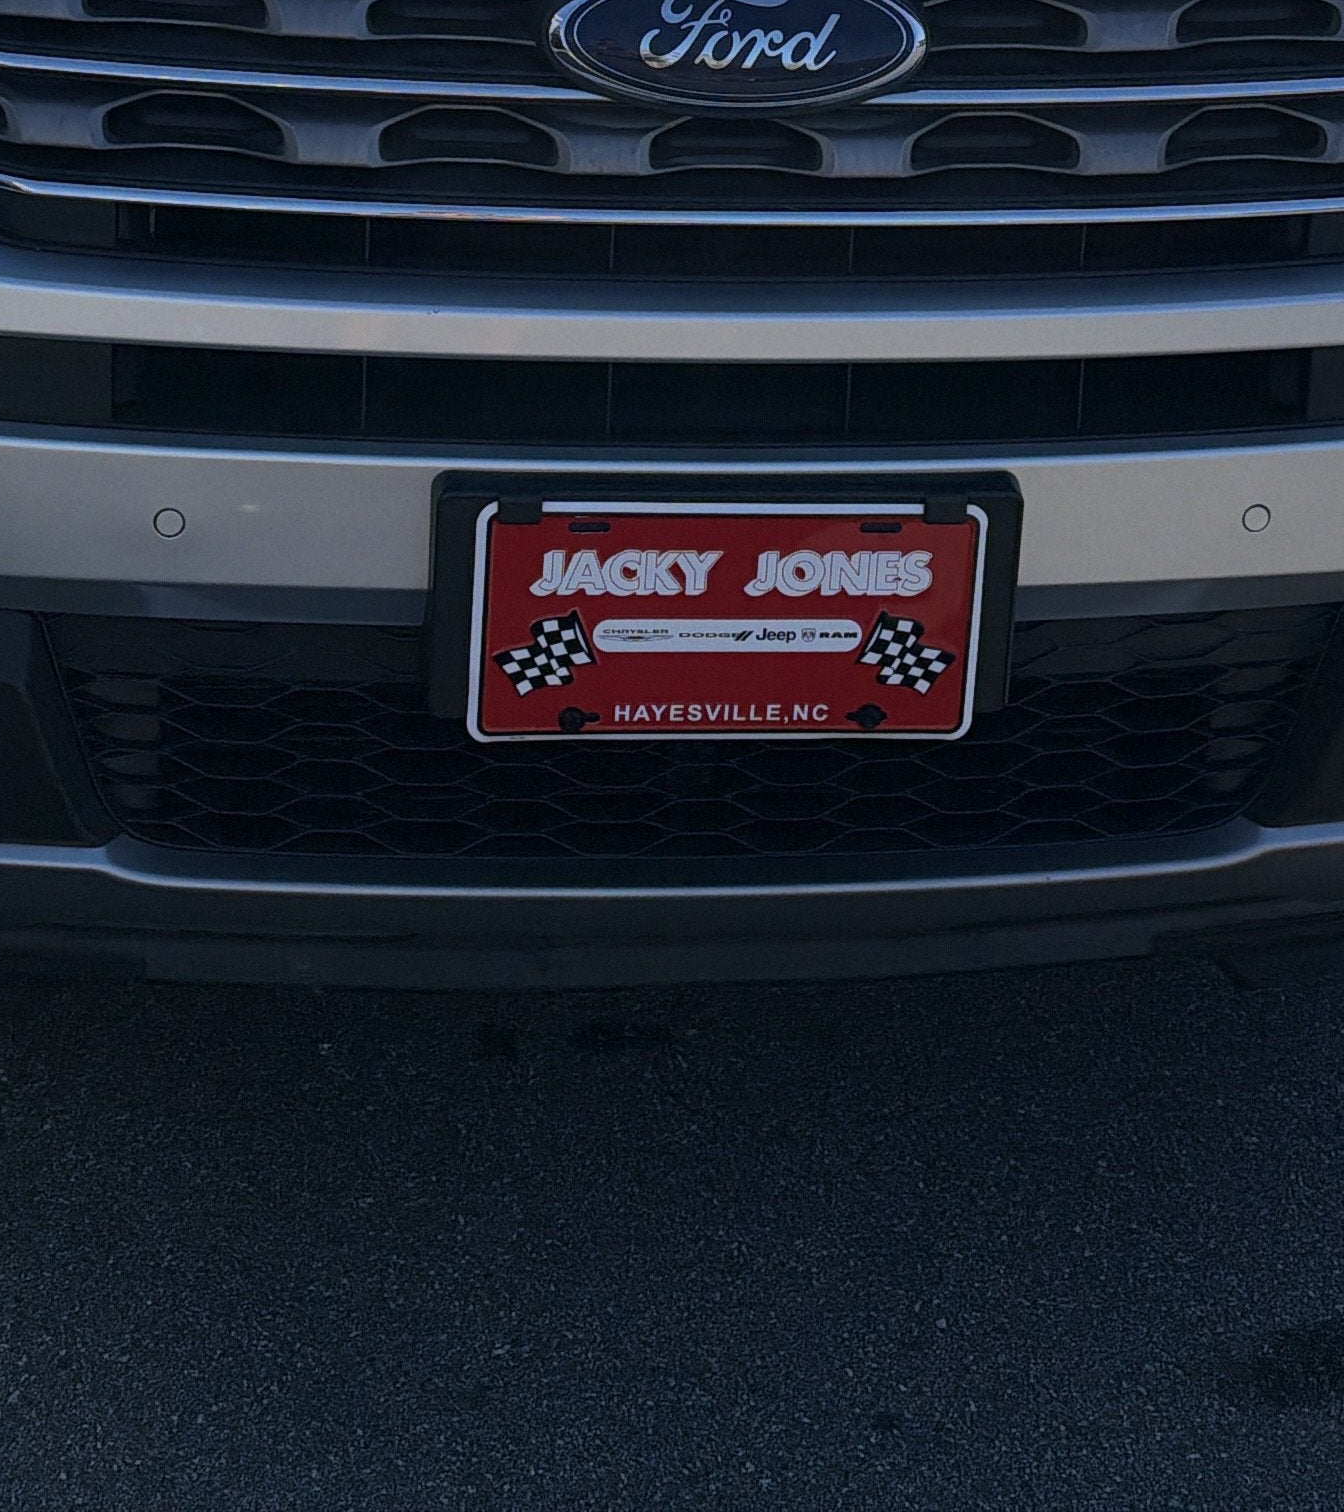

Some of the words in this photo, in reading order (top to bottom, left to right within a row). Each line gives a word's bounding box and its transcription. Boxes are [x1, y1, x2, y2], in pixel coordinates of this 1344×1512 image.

[529, 549, 724, 597] JACKY
[743, 550, 933, 597] JONES
[755, 628, 796, 643] Jeep
